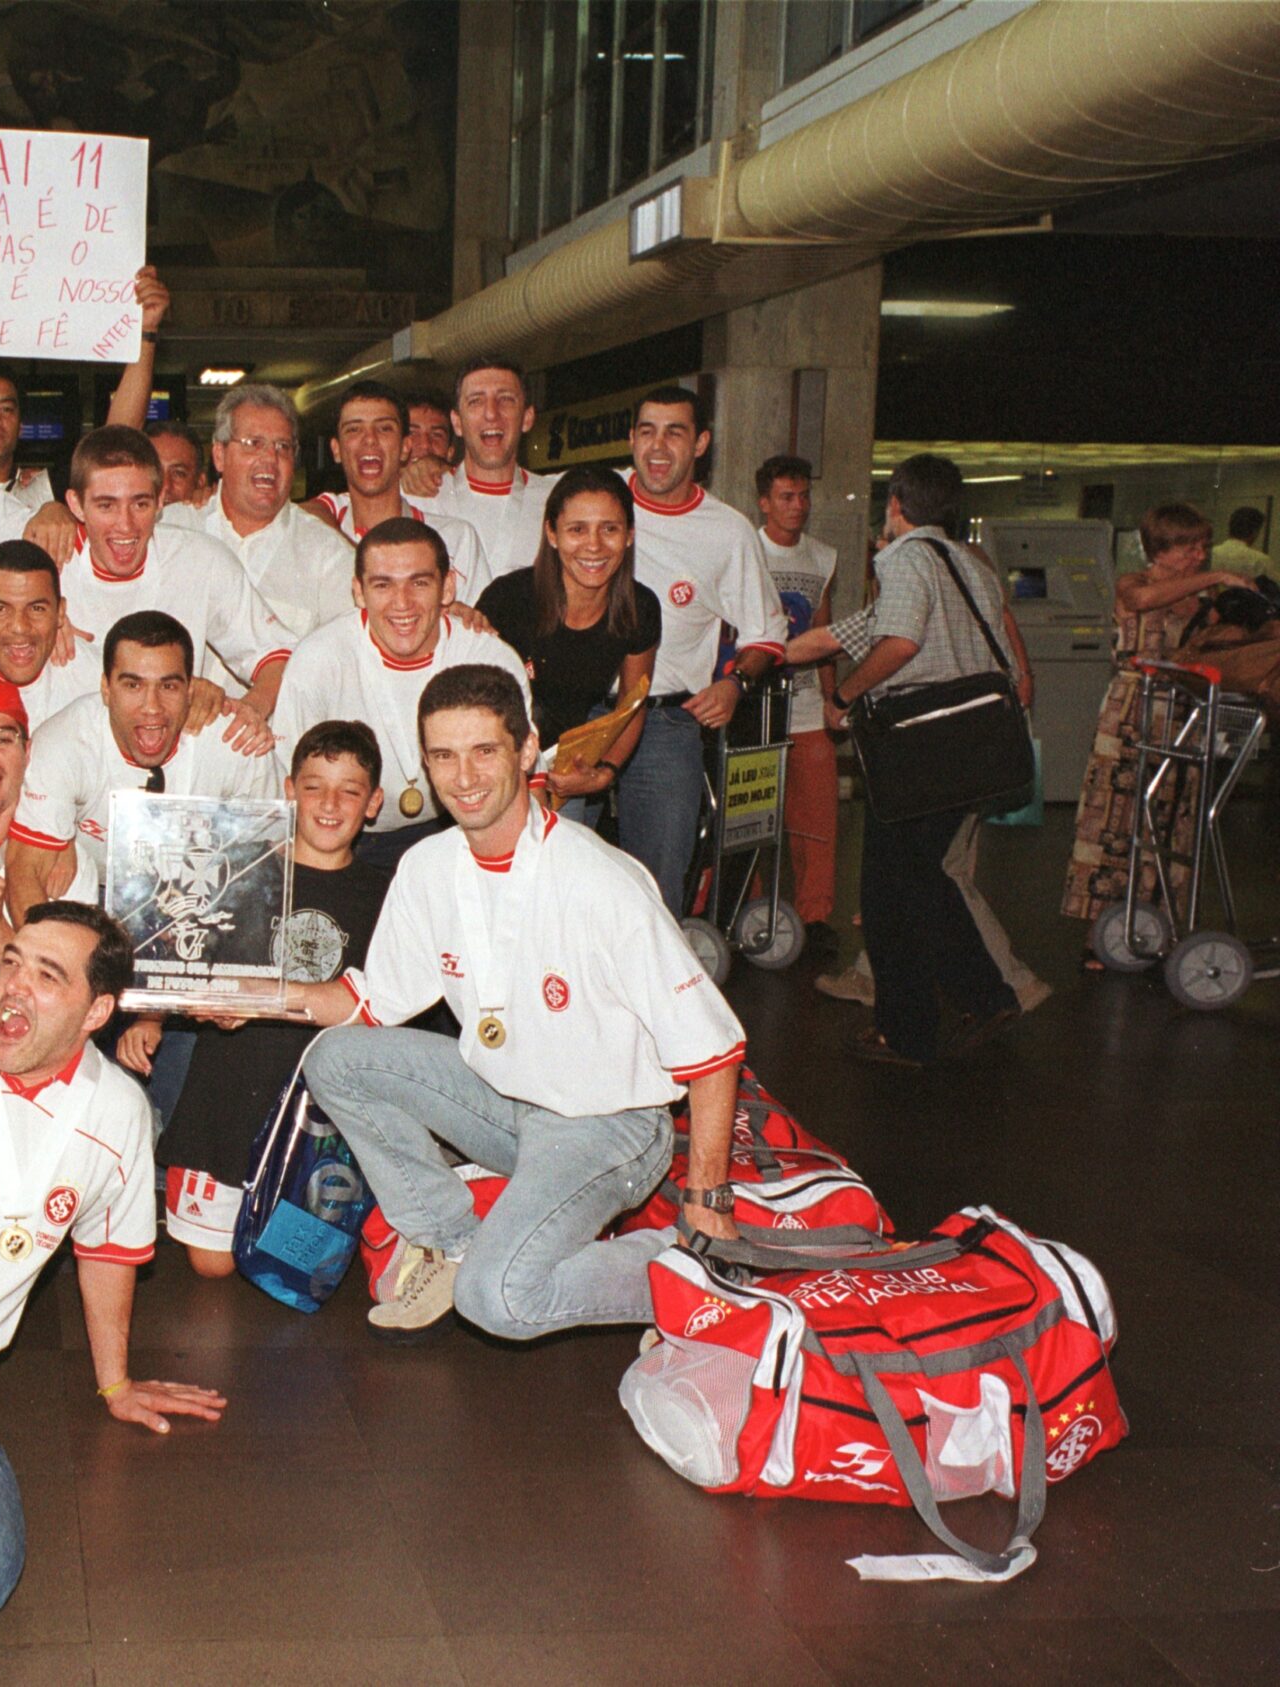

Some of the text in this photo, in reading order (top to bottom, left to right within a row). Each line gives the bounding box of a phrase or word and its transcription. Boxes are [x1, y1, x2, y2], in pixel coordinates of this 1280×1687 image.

[70, 141, 103, 189] 11
[38, 186, 58, 229] É
[84, 203, 117, 234] DE
[71, 240, 88, 266] O
[11, 267, 29, 301] É
[58, 277, 135, 304] NOSSO
[0, 319, 15, 345] E
[36, 312, 71, 348] FÊ
[91, 313, 139, 360] INTER
[728, 791, 750, 808] ZERO
[872, 1268, 946, 1286] CLUB
